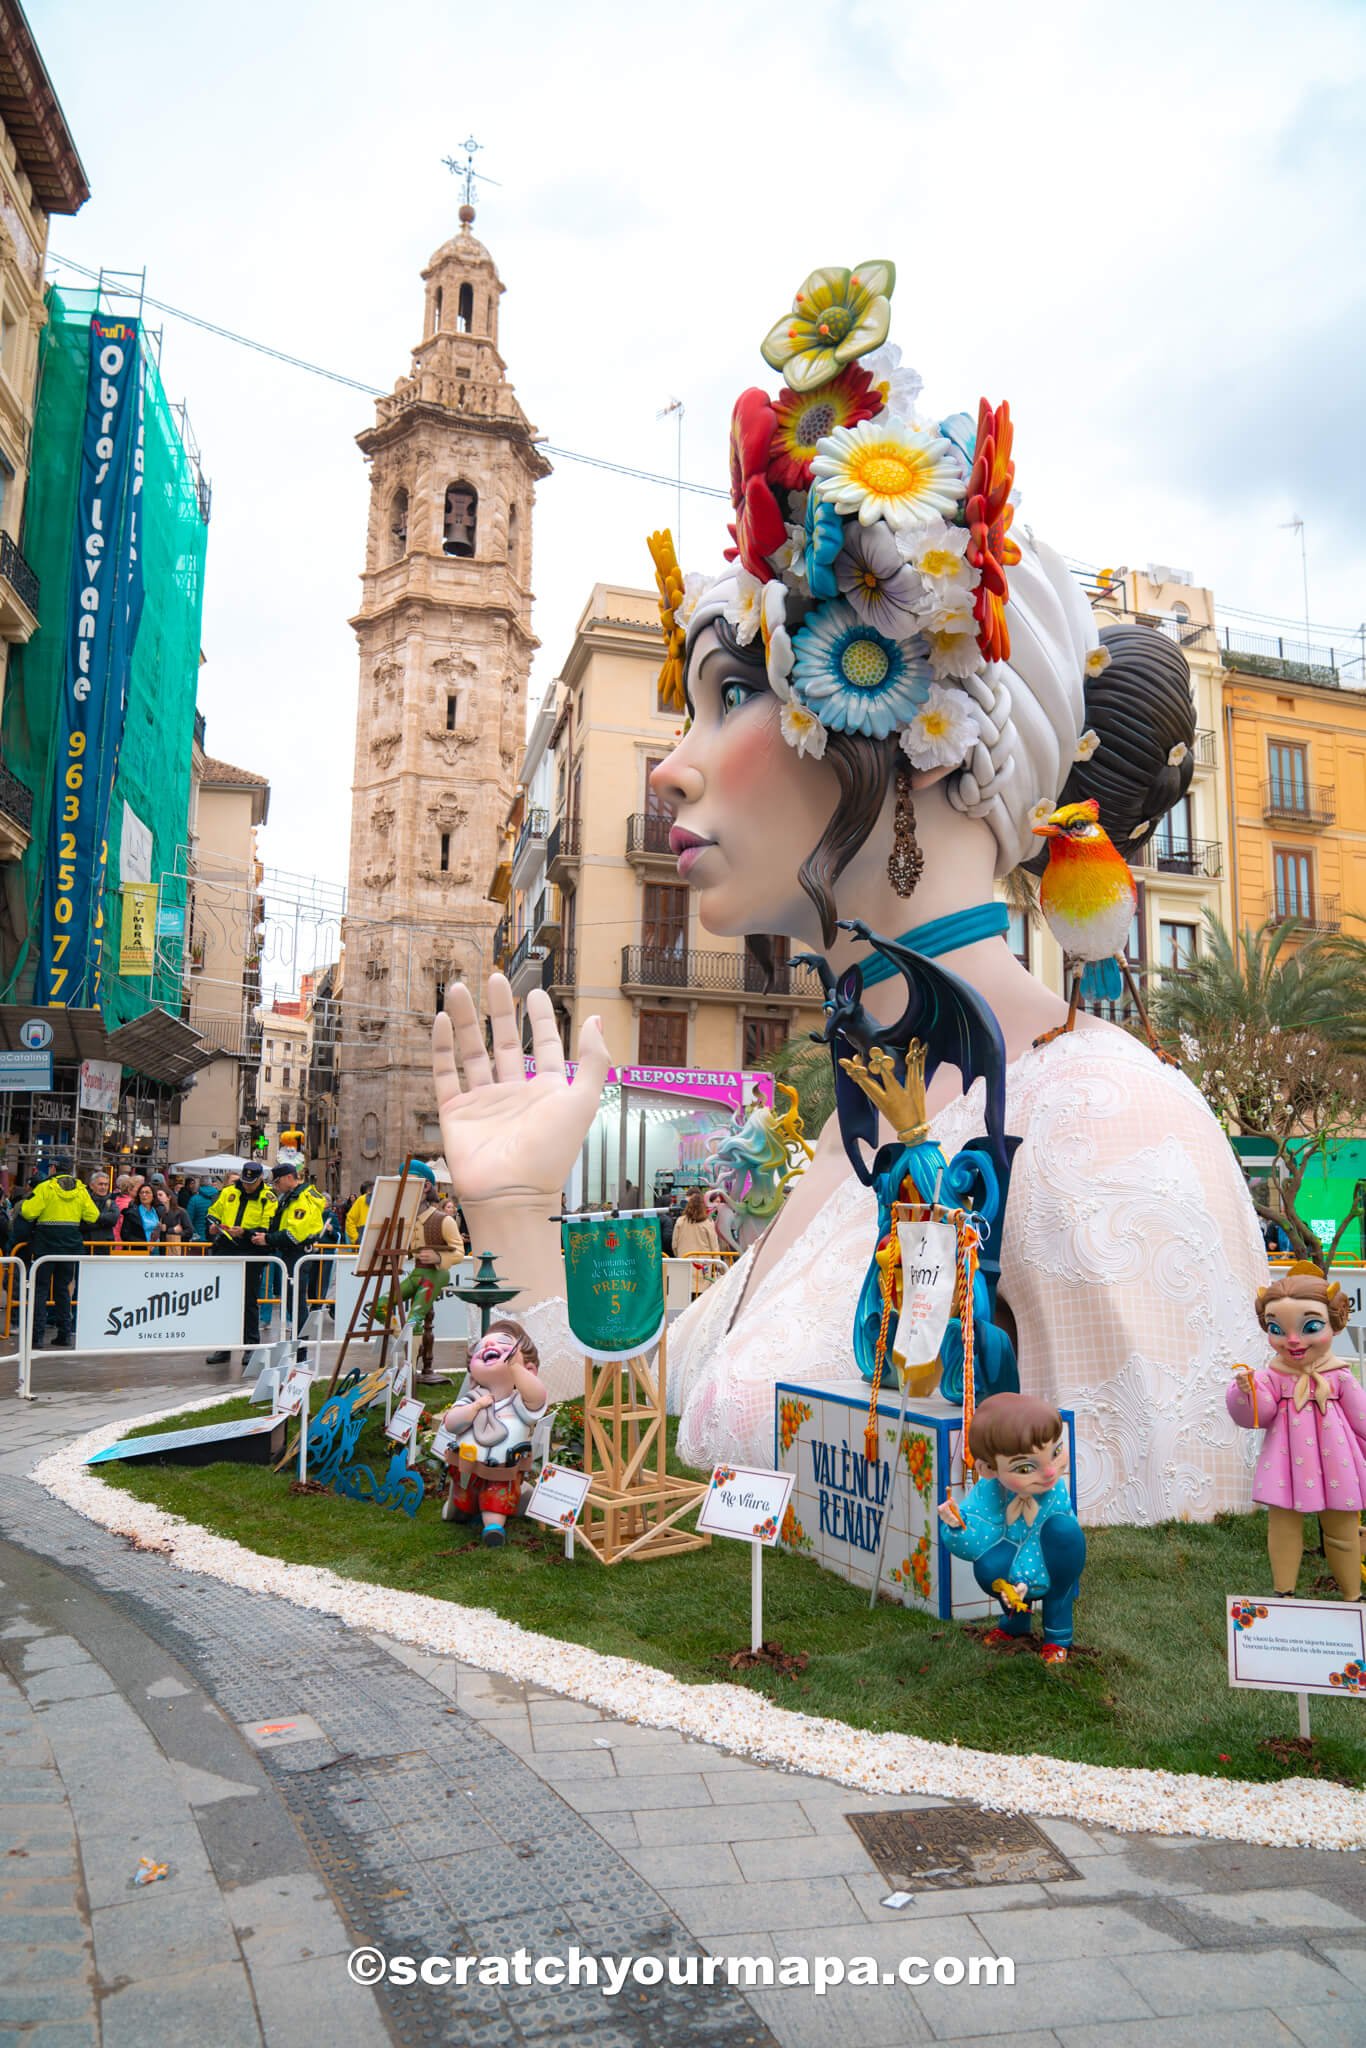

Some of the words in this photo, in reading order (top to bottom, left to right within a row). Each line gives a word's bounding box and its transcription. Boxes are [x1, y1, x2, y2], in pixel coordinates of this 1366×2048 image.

[95, 344, 125, 486] Obras
[133, 901, 144, 946] CIMBRA
[630, 1070, 738, 1087] REPOSTERIA
[144, 1271, 185, 1279] CERVEZAS
[592, 1280, 638, 1295] PREMI
[611, 1295, 620, 1314] 5
[165, 1331, 186, 1339] 1890
[819, 1489, 884, 1554] RENAIX
